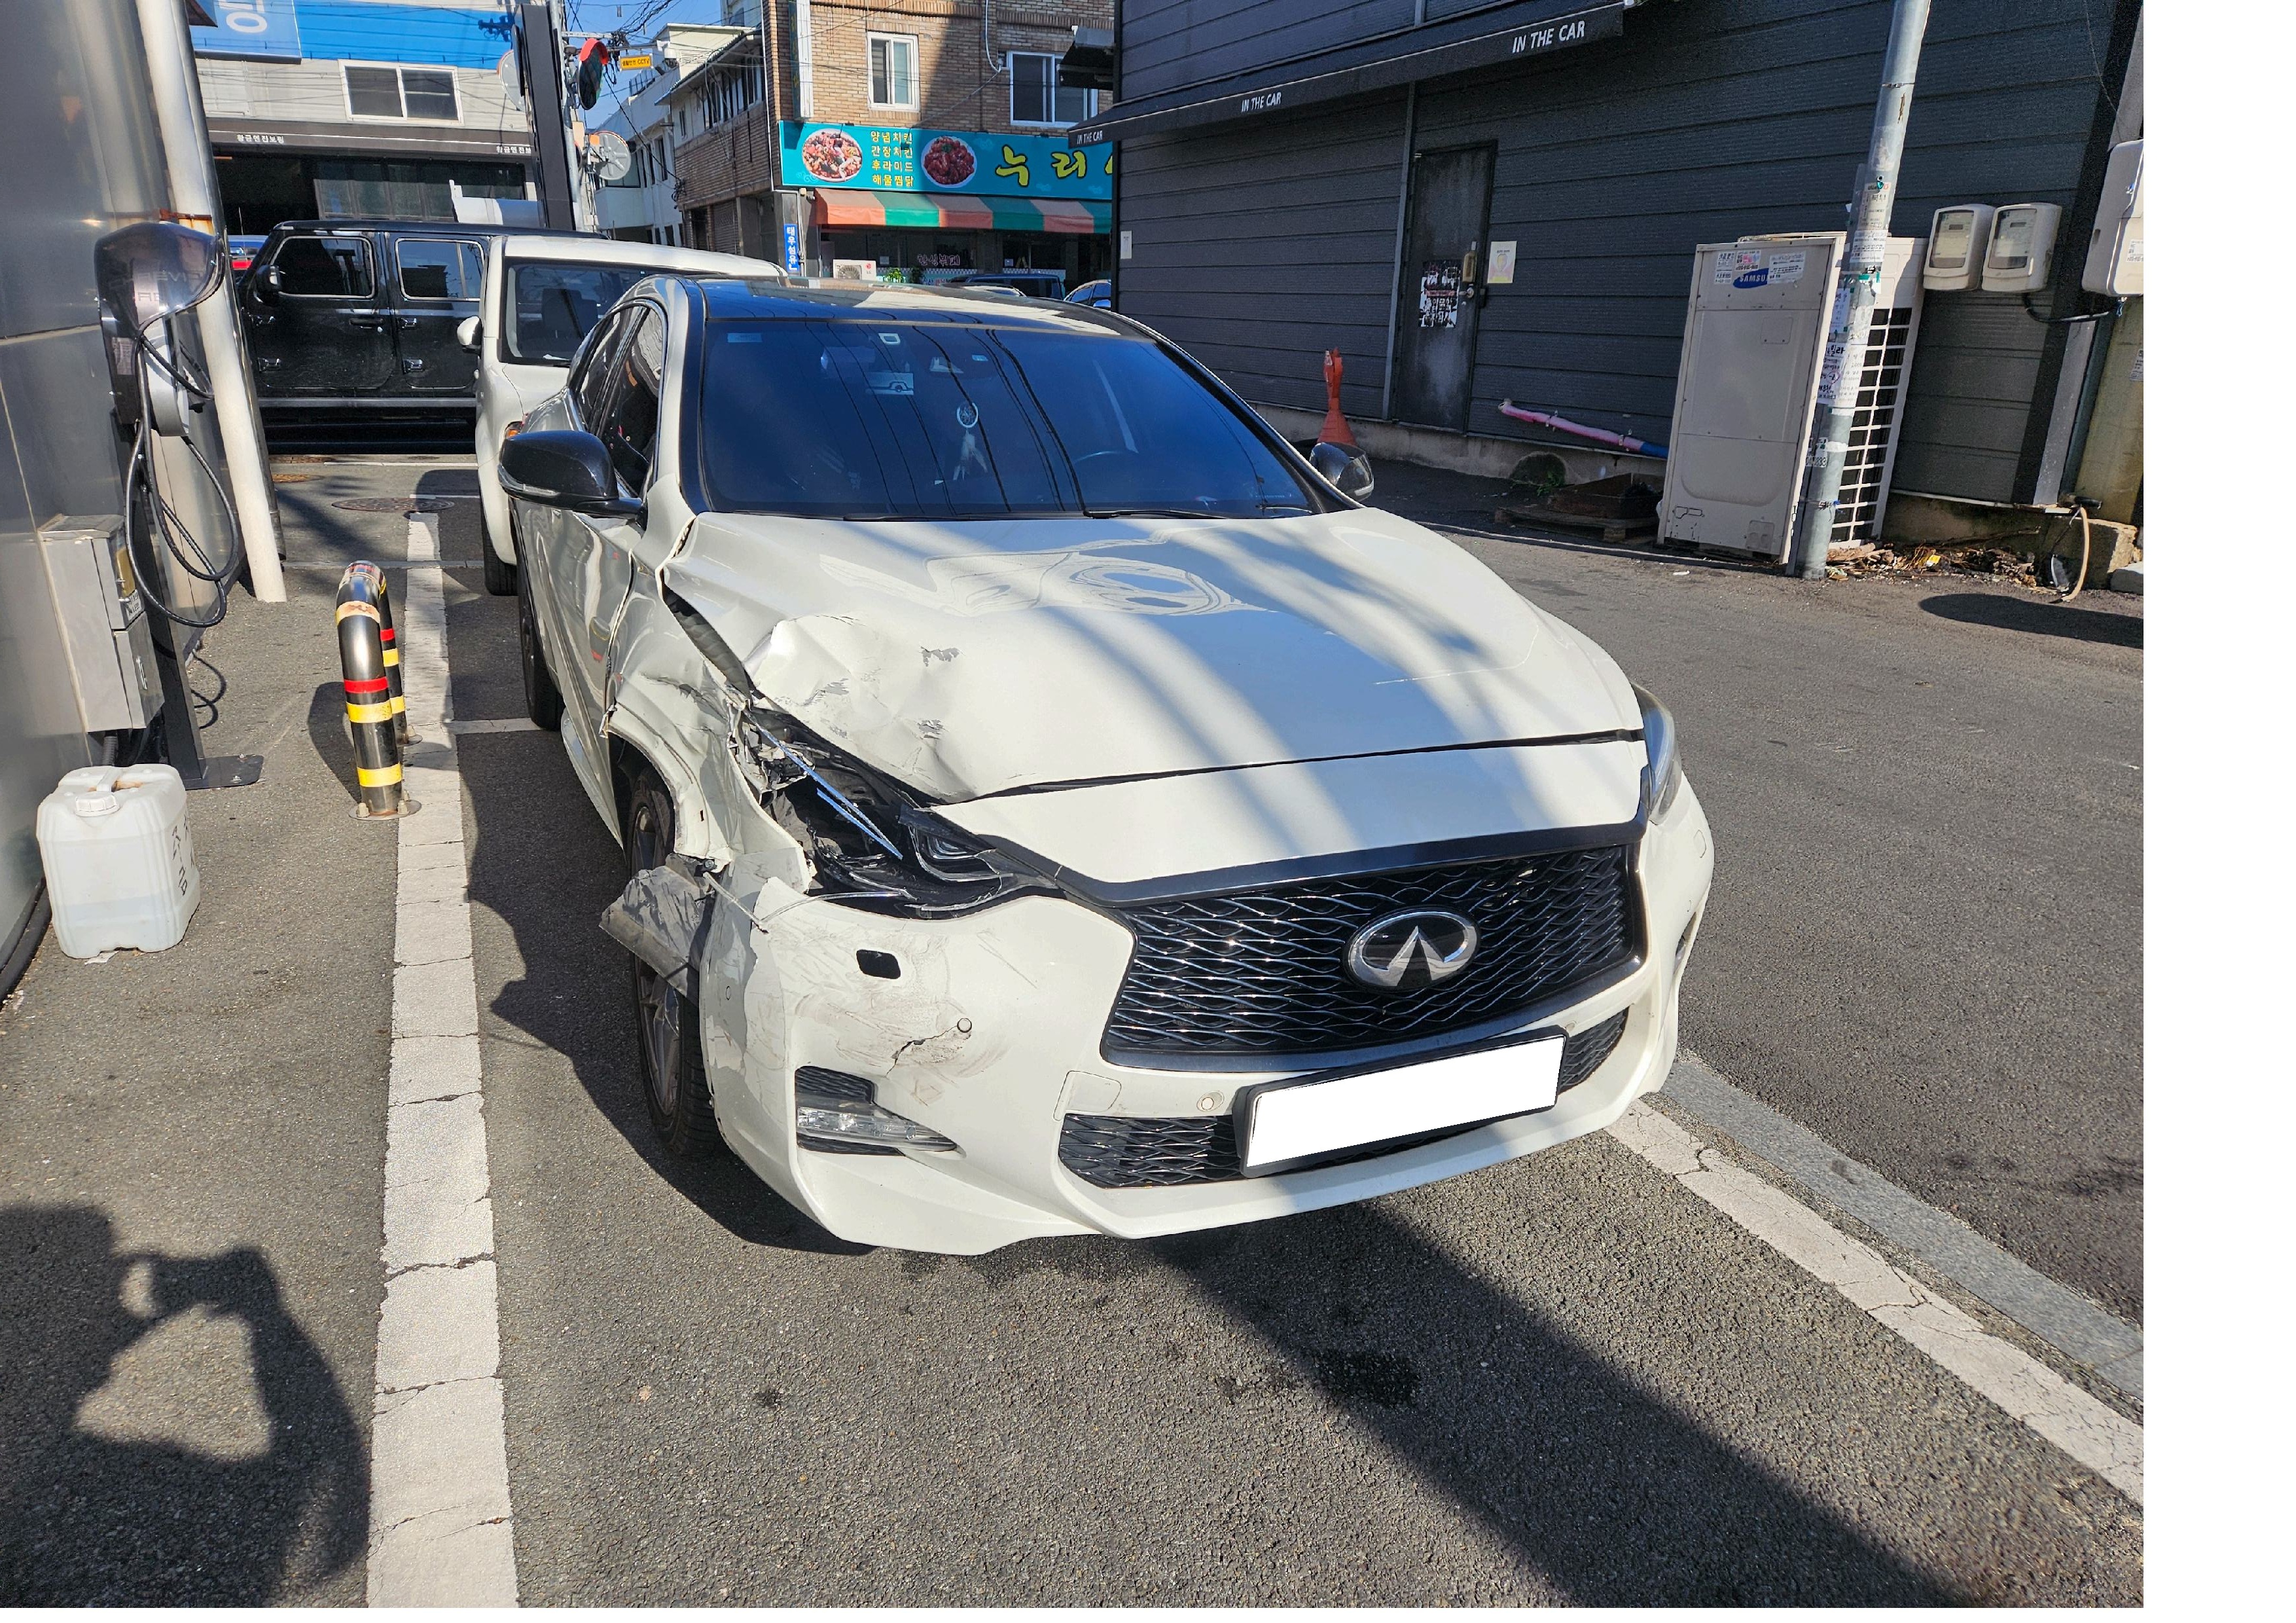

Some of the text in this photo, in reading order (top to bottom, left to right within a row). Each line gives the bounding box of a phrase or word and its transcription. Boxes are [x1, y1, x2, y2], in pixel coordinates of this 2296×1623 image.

[1512, 20, 1586, 53] IN THE CAR
[1241, 92, 1282, 113] IN THE CAR
[870, 130, 913, 145] 양념치킨
[1077, 130, 1103, 145] IN THE CAR
[871, 145, 913, 159] 간장치킨
[996, 144, 1113, 187] 누리
[872, 173, 914, 187] 해물찜닭
[1739, 273, 1767, 283] SAMSU
